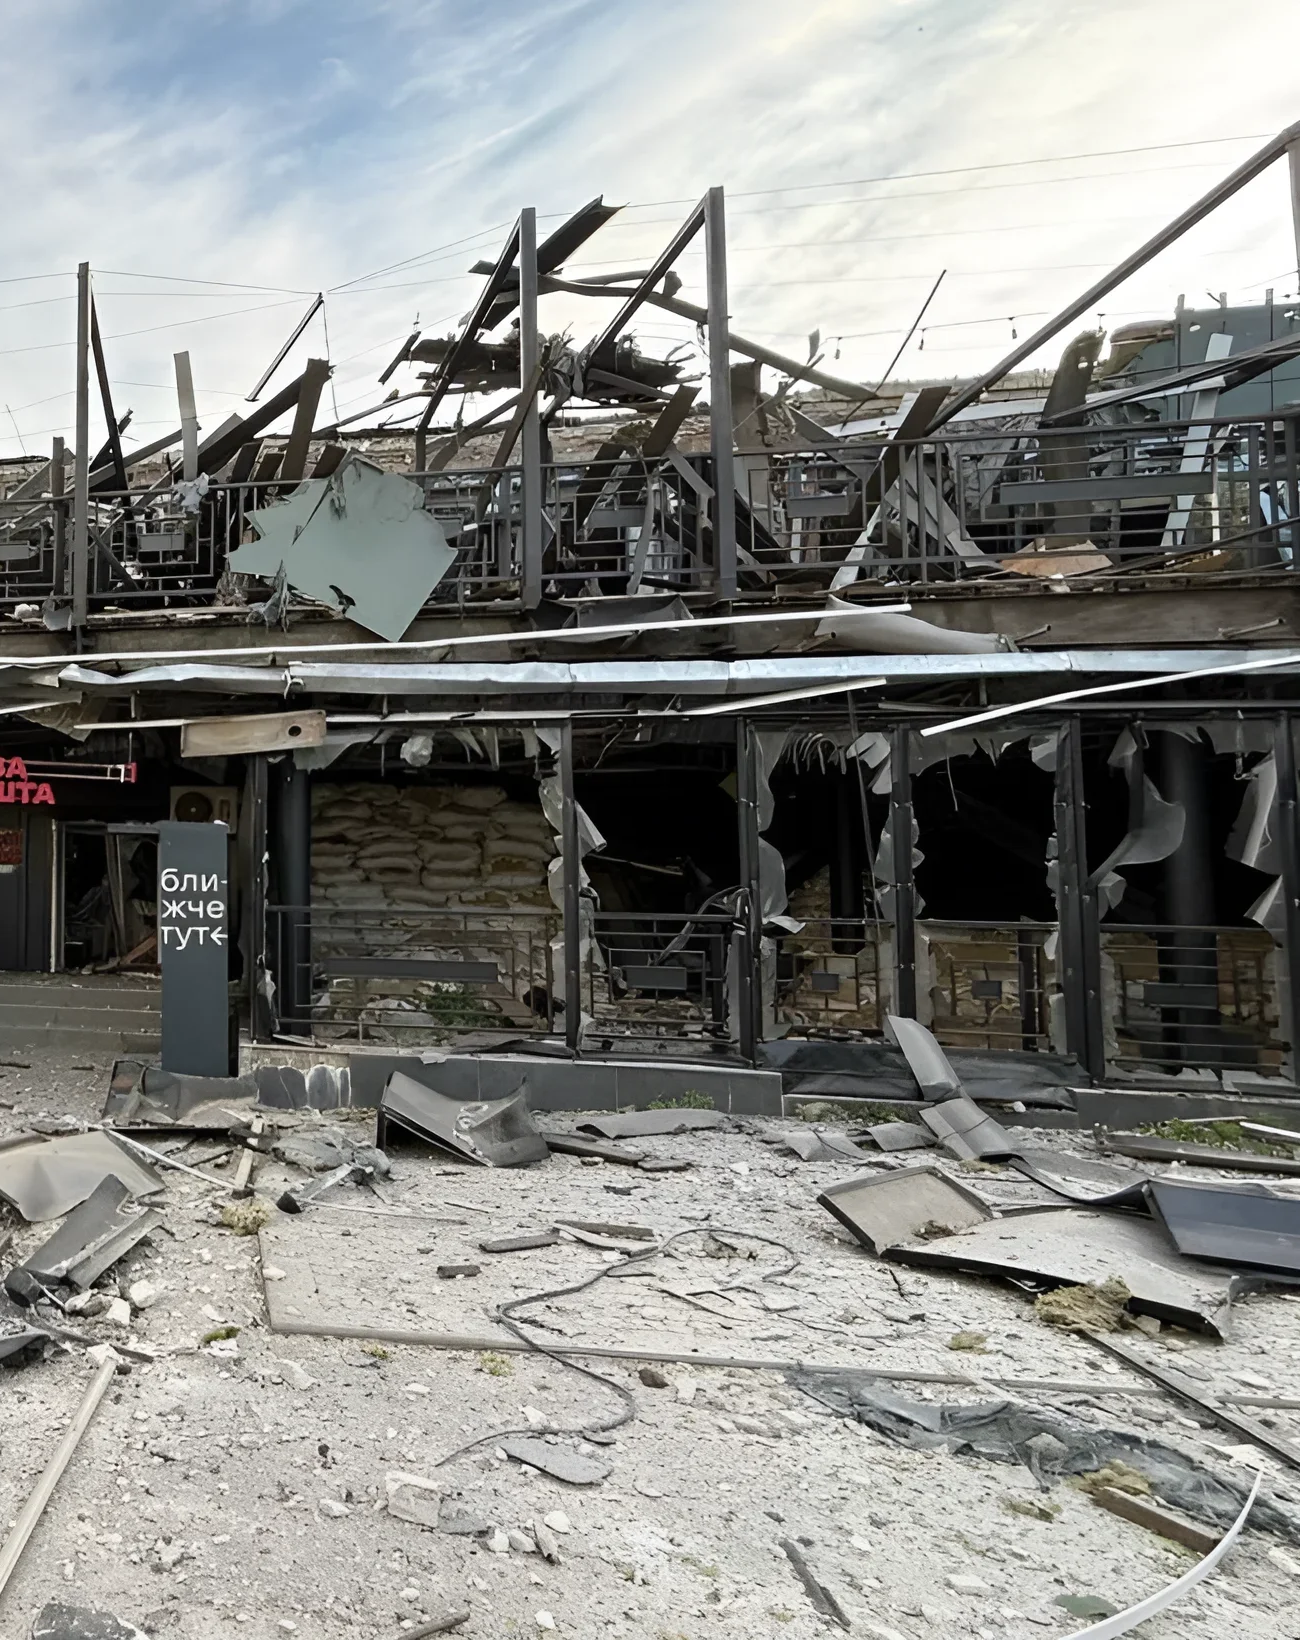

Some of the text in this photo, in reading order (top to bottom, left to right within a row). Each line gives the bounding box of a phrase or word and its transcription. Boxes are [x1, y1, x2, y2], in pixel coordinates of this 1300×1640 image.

[160, 867, 228, 892] бли-
[161, 899, 225, 919] жче
[160, 926, 210, 951] тут
